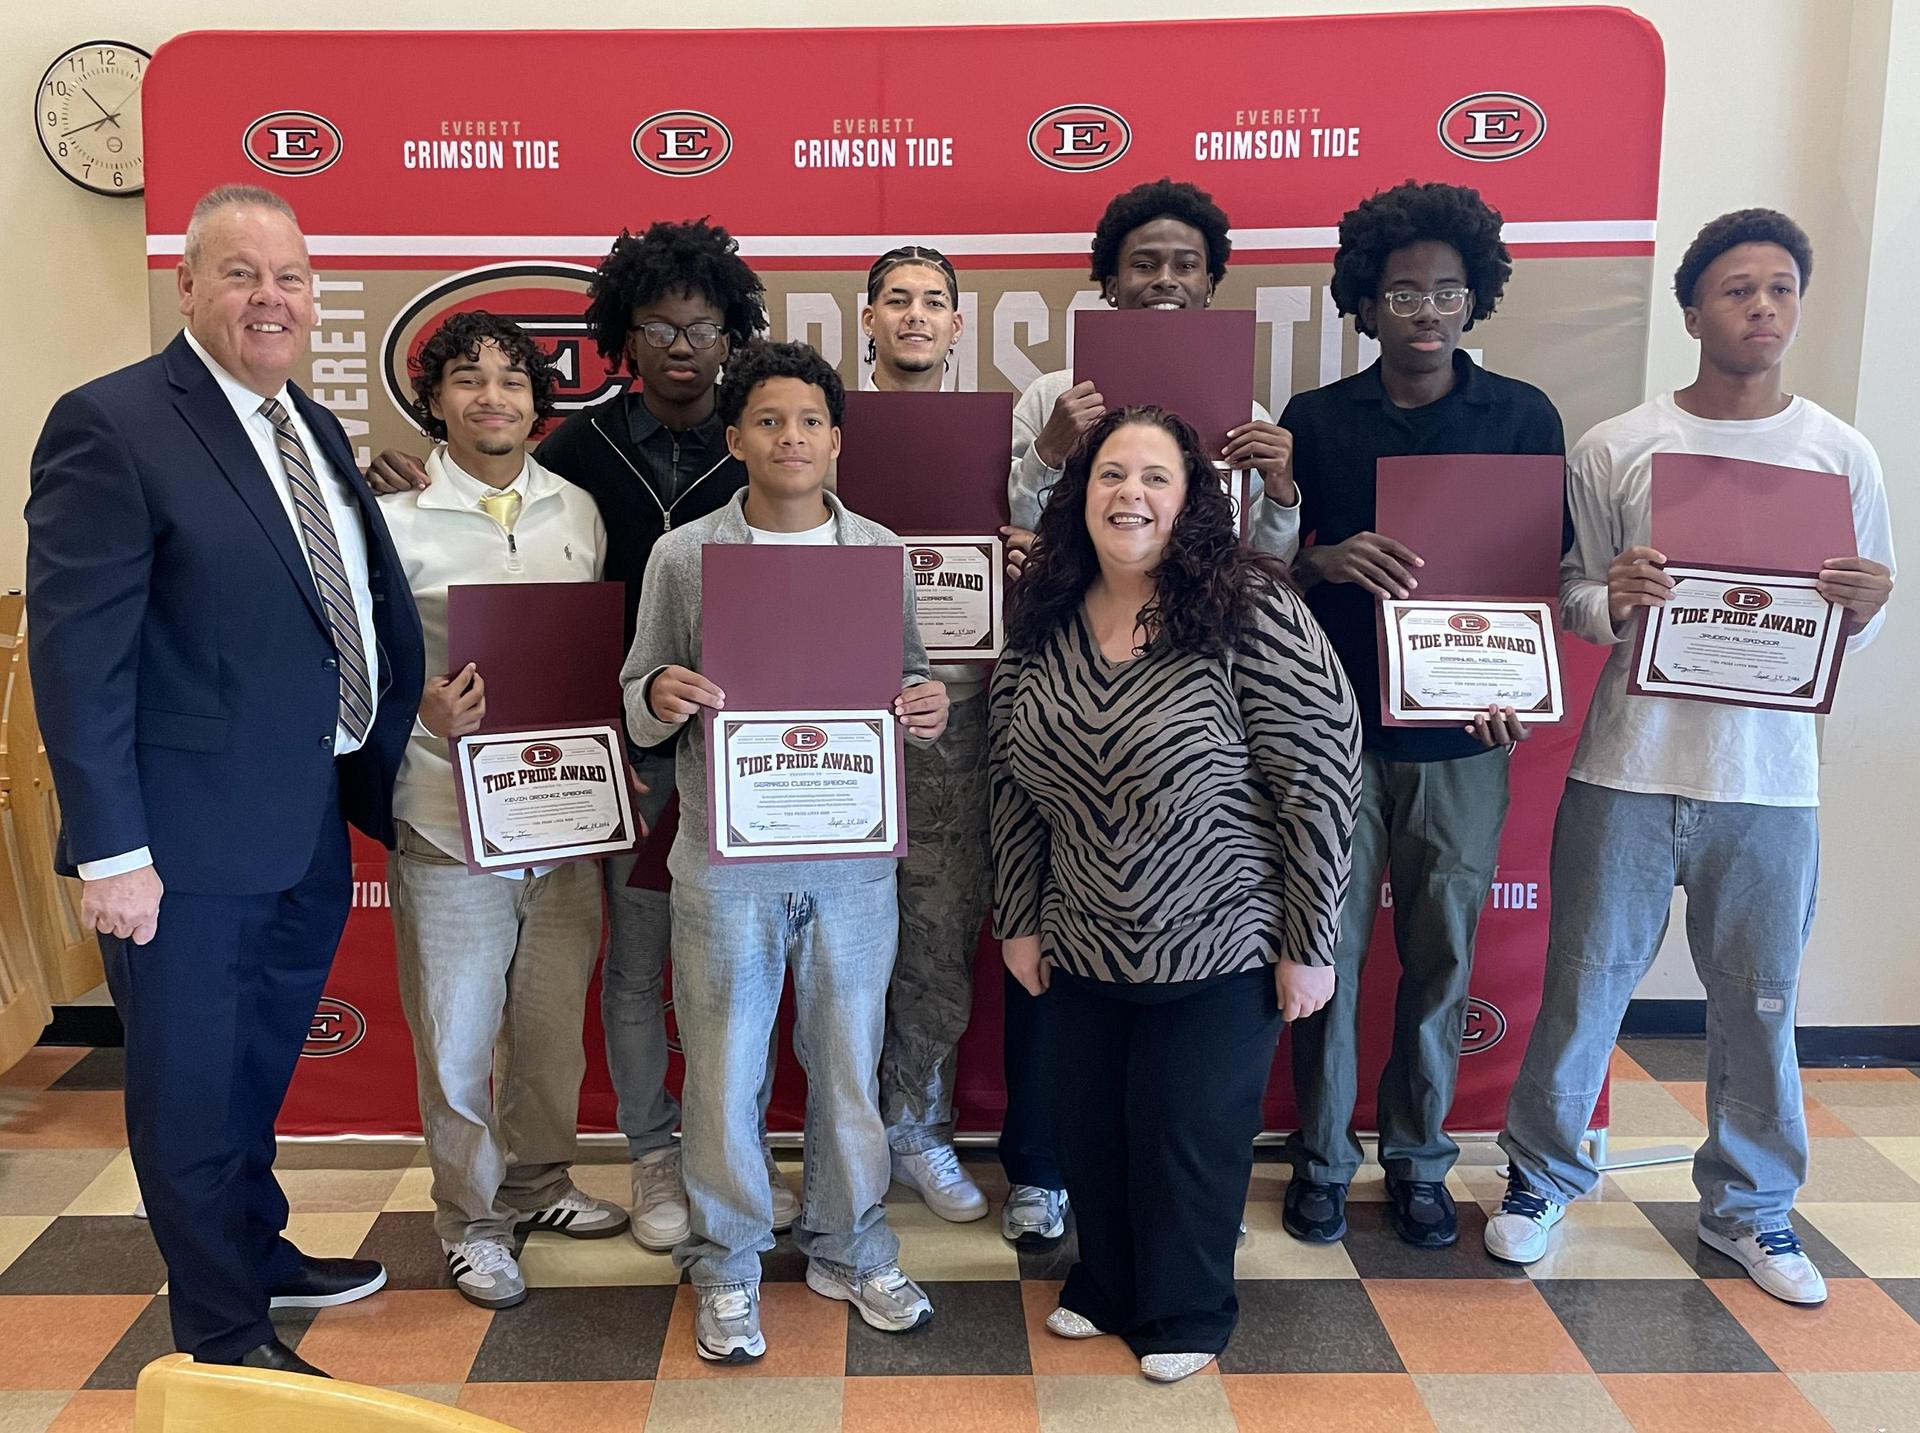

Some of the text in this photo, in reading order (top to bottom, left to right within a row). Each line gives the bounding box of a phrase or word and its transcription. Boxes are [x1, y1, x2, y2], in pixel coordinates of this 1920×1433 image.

[68, 57, 85, 73] 11
[97, 50, 116, 65] 12
[134, 58, 141, 73] 1
[47, 80, 67, 97] 10
[47, 111, 57, 127] 9
[1236, 108, 1321, 126] EVERETT
[441, 121, 521, 136] EVERETT
[833, 118, 915, 134] EVERETT
[1463, 109, 1524, 145] E
[268, 128, 323, 160] E
[656, 127, 712, 160] E
[1053, 121, 1111, 156] E
[1195, 128, 1360, 161] CRIMSON TIDE
[58, 141, 68, 157] 8
[403, 141, 560, 169] CRIMSON TIDE
[794, 137, 953, 168] CRIMSON TIDE
[82, 164, 92, 179] 7
[113, 171, 124, 187] 6
[913, 554, 934, 567] E
[915, 572, 984, 592] IDE AWARD
[1735, 592, 1761, 607] E
[1459, 618, 1481, 630] E
[1671, 607, 1818, 638] TIDE PRIDE AWARD
[1408, 633, 1536, 655] TIDE PRIDE AWARD
[793, 732, 817, 747] E
[531, 749, 554, 763] E
[737, 752, 874, 778] TIDE PRIDE AWARD
[483, 765, 607, 794] TIDE PRIDE AWARD
[1491, 883, 1538, 909] TIDE
